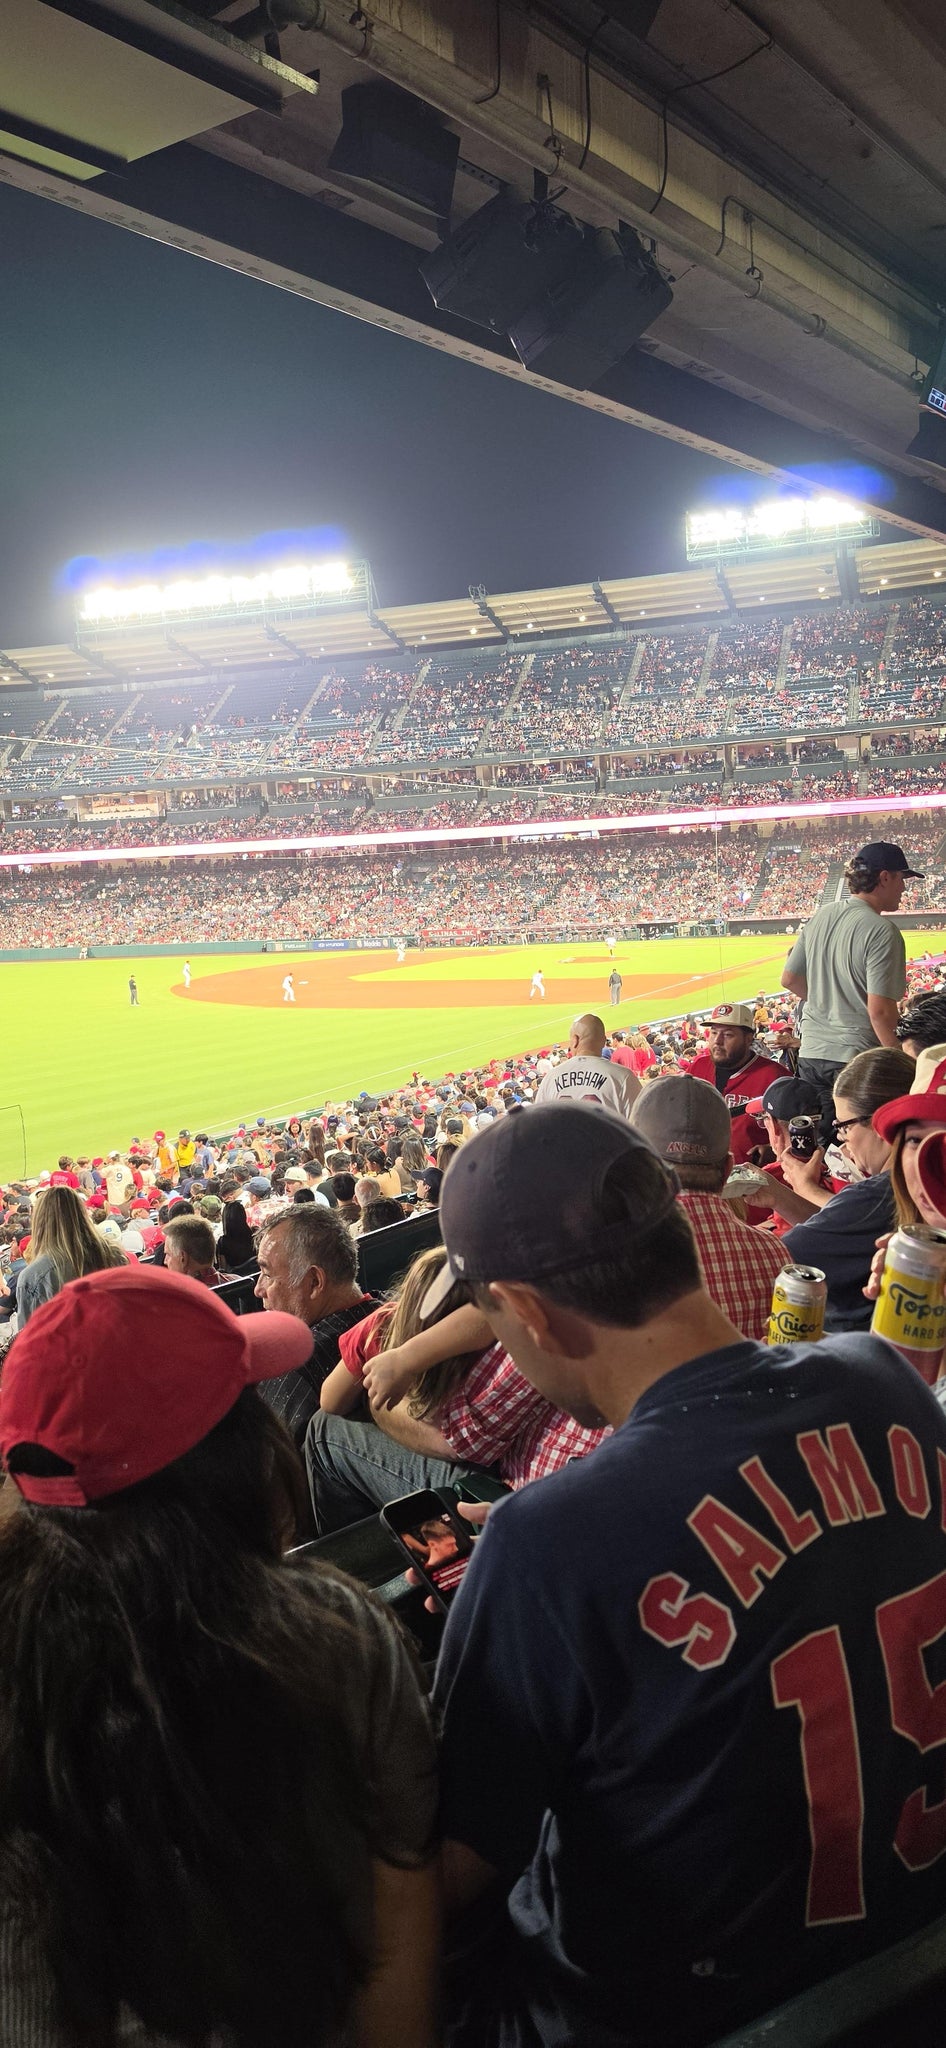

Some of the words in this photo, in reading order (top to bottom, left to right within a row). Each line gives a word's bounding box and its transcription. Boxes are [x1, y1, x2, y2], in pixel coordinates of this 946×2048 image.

[555, 1071, 607, 1092] KERSHAW
[666, 1141, 708, 1157] ANGELS
[116, 1172, 123, 1182] 9
[889, 1282, 946, 1320] Topo
[903, 1324, 934, 1340] HARD
[638, 1422, 946, 1671] SALMO
[771, 1569, 946, 1927] 15
